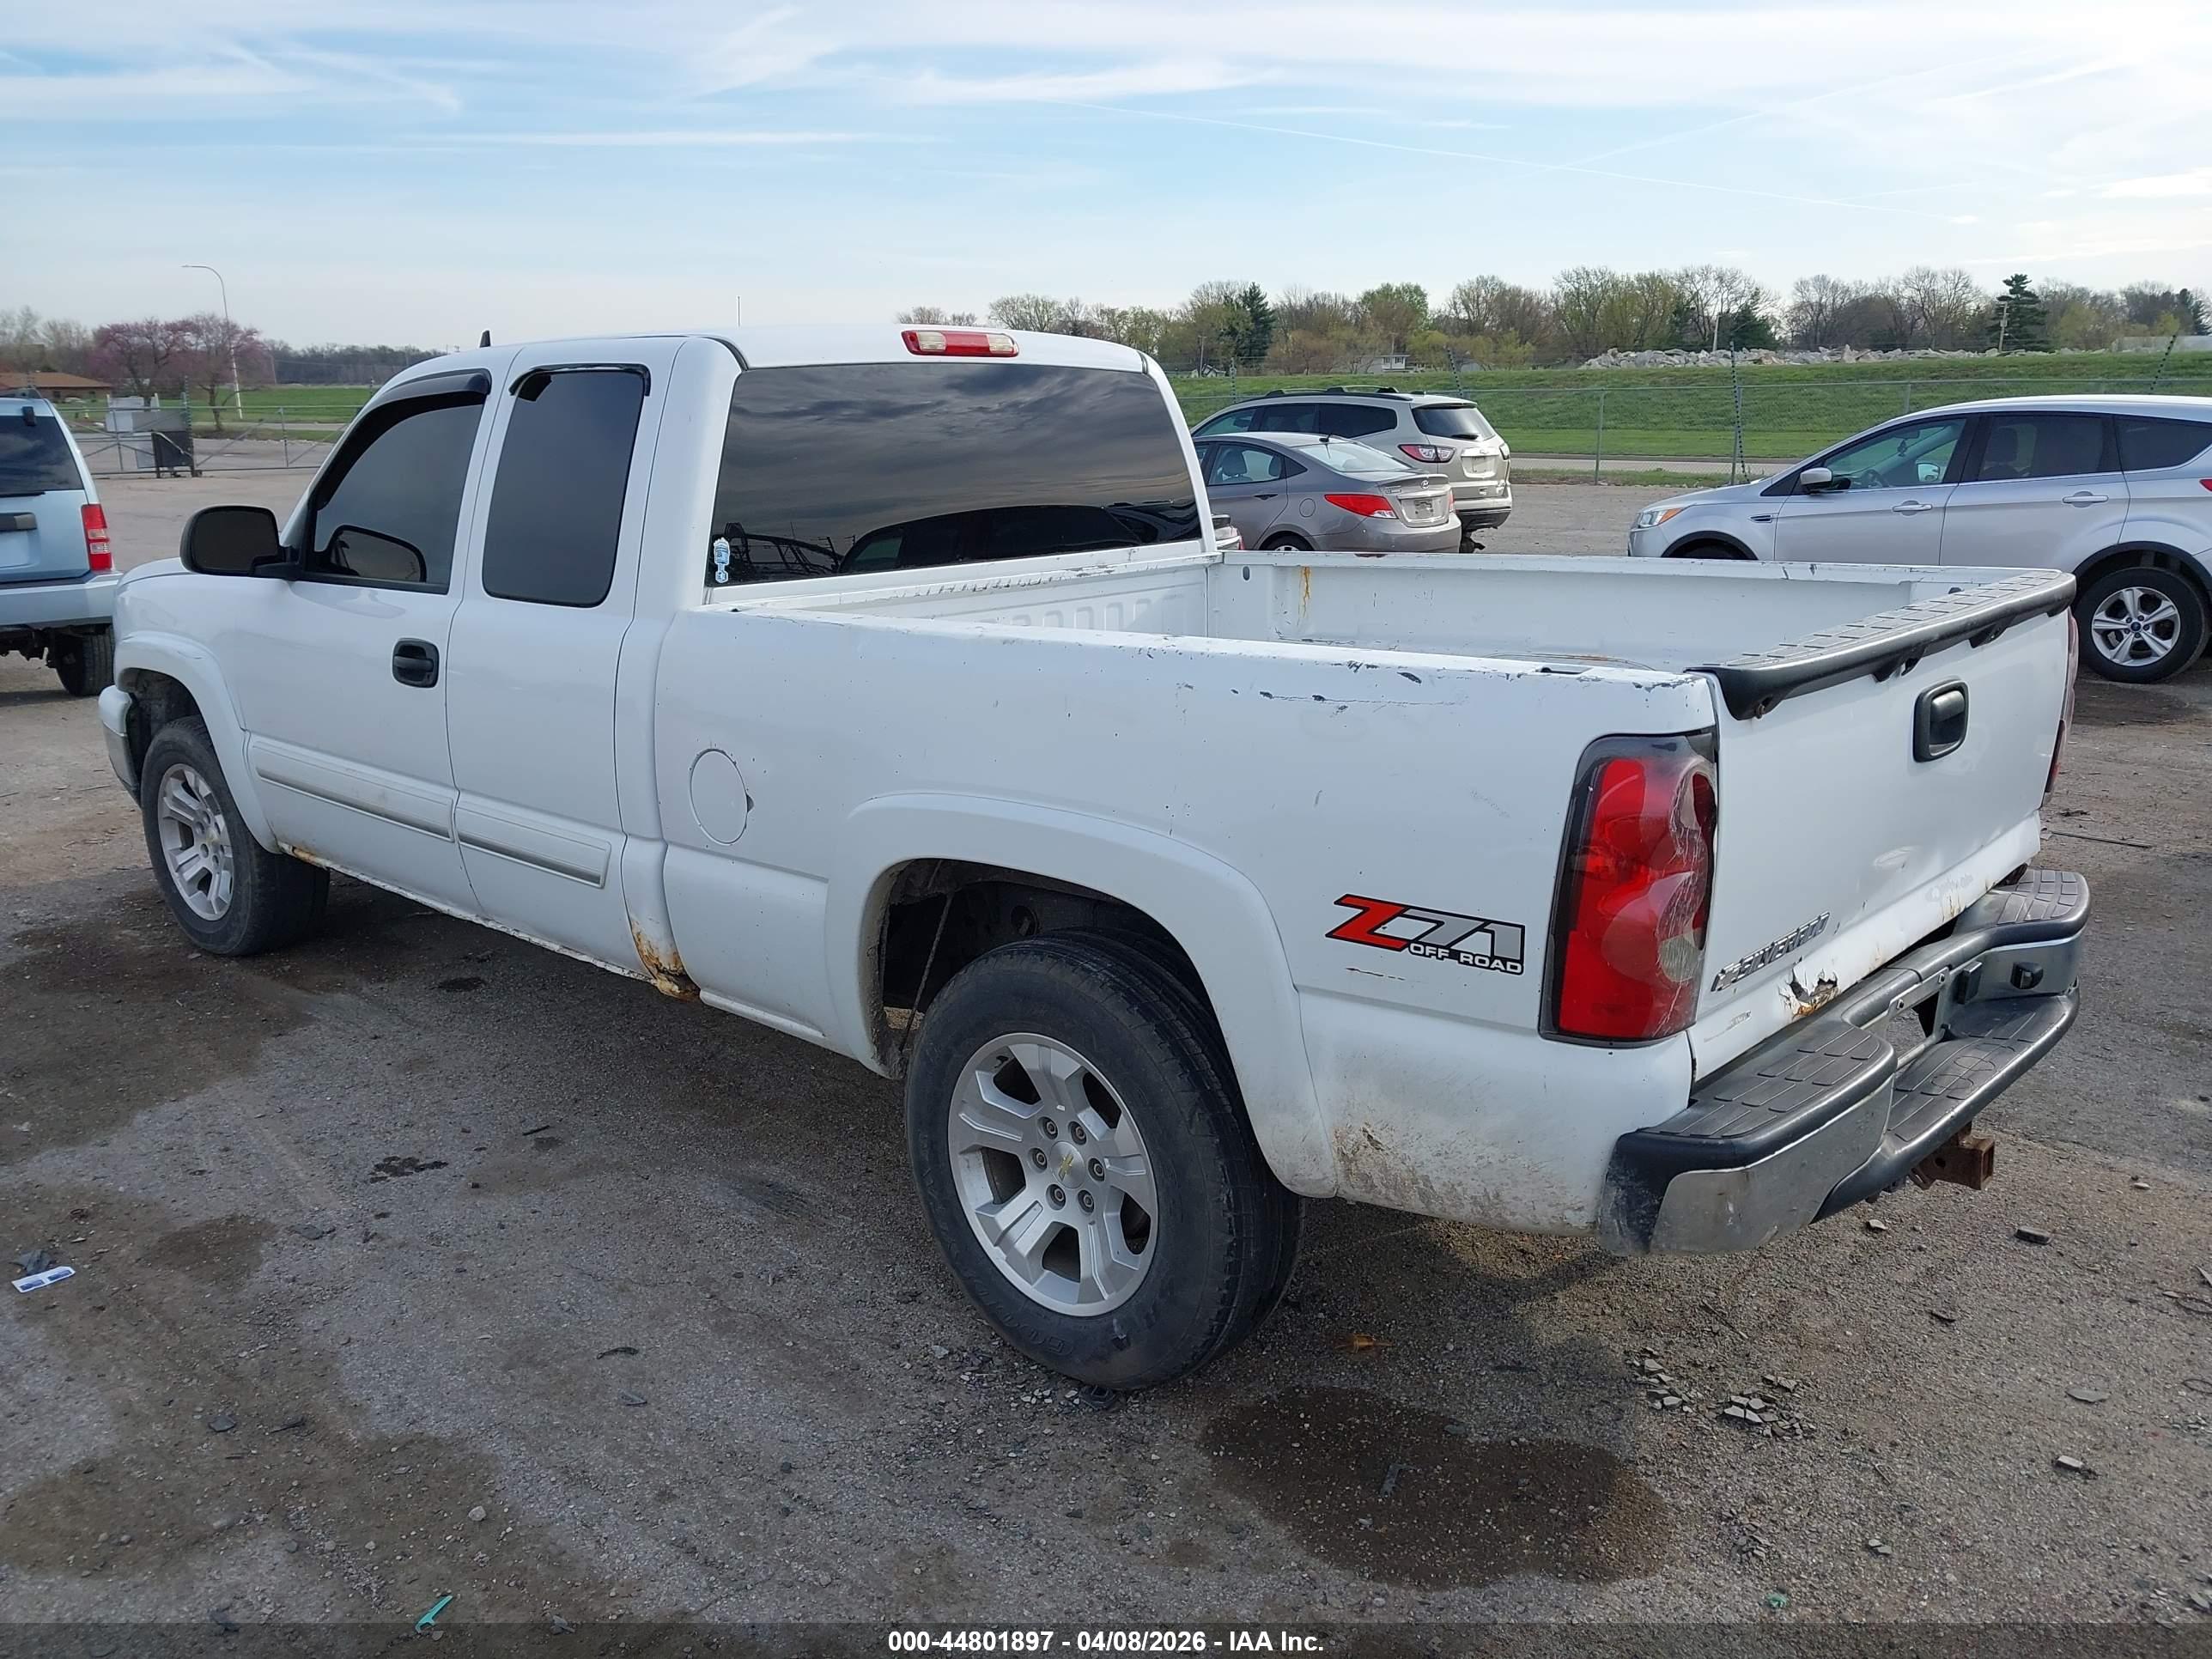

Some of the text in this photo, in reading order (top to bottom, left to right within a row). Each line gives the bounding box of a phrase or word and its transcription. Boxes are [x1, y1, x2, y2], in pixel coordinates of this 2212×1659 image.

[1325, 894, 1525, 960] Z71
[1409, 943, 1523, 975] OFF ROAD
